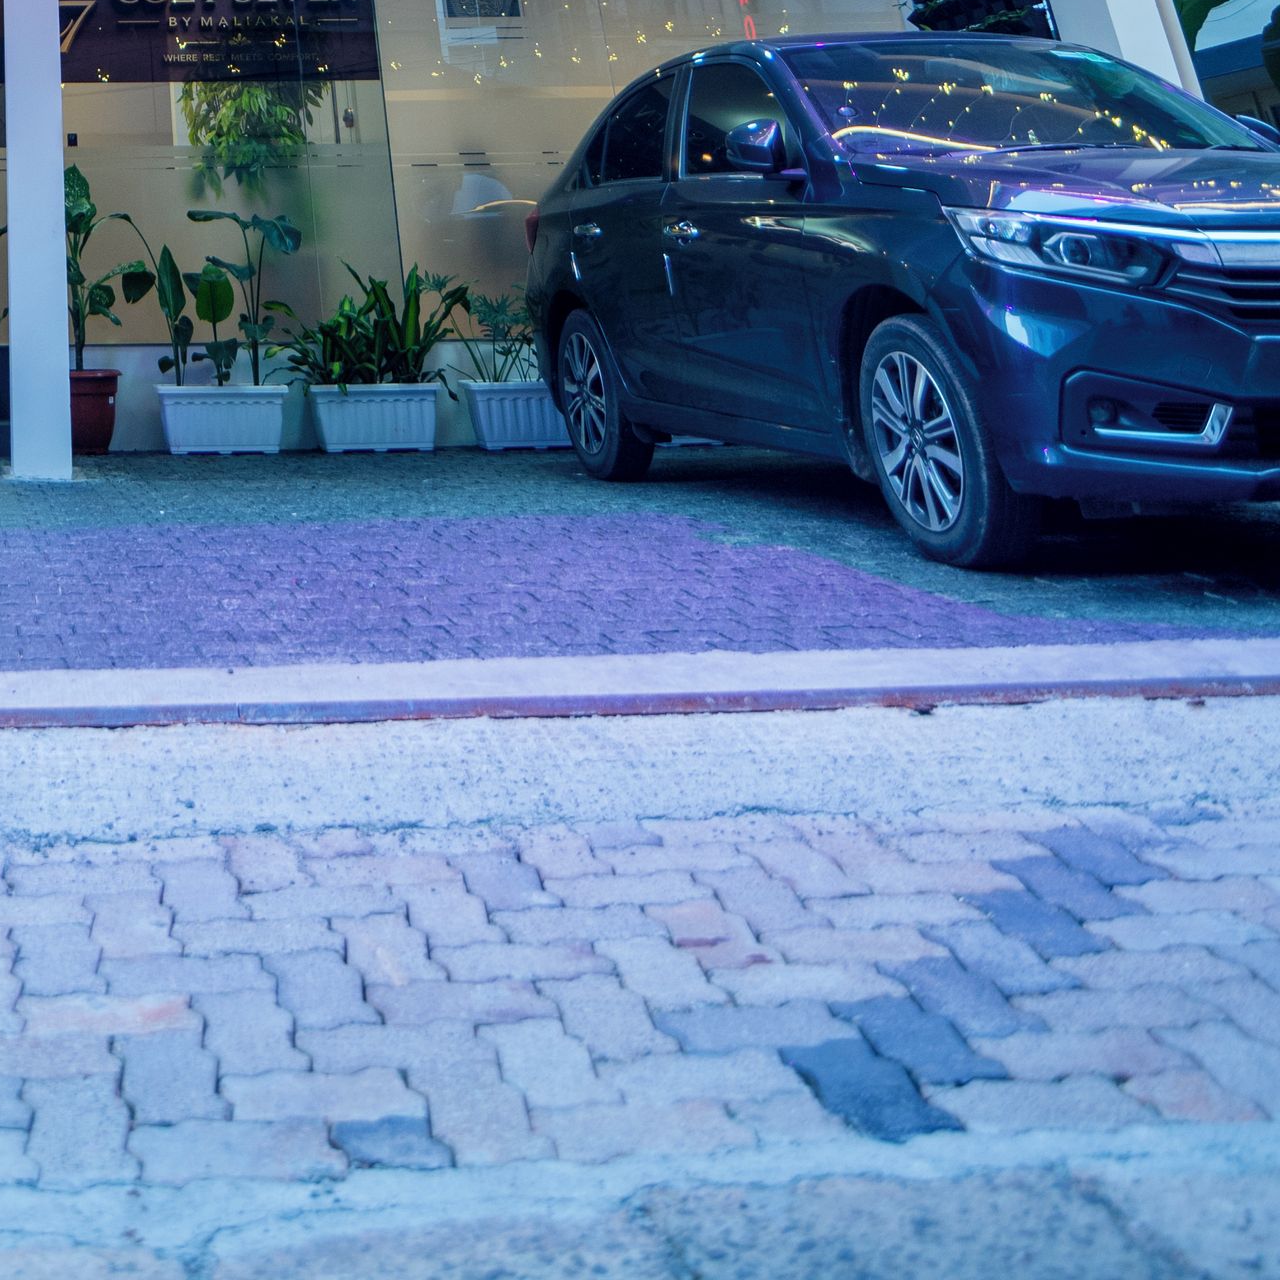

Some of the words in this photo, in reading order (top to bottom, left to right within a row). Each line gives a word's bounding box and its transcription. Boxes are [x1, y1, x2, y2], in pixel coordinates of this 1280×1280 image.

[168, 16, 192, 27] BY
[200, 15, 309, 27] MALIAKAL
[163, 53, 198, 62] WHERE
